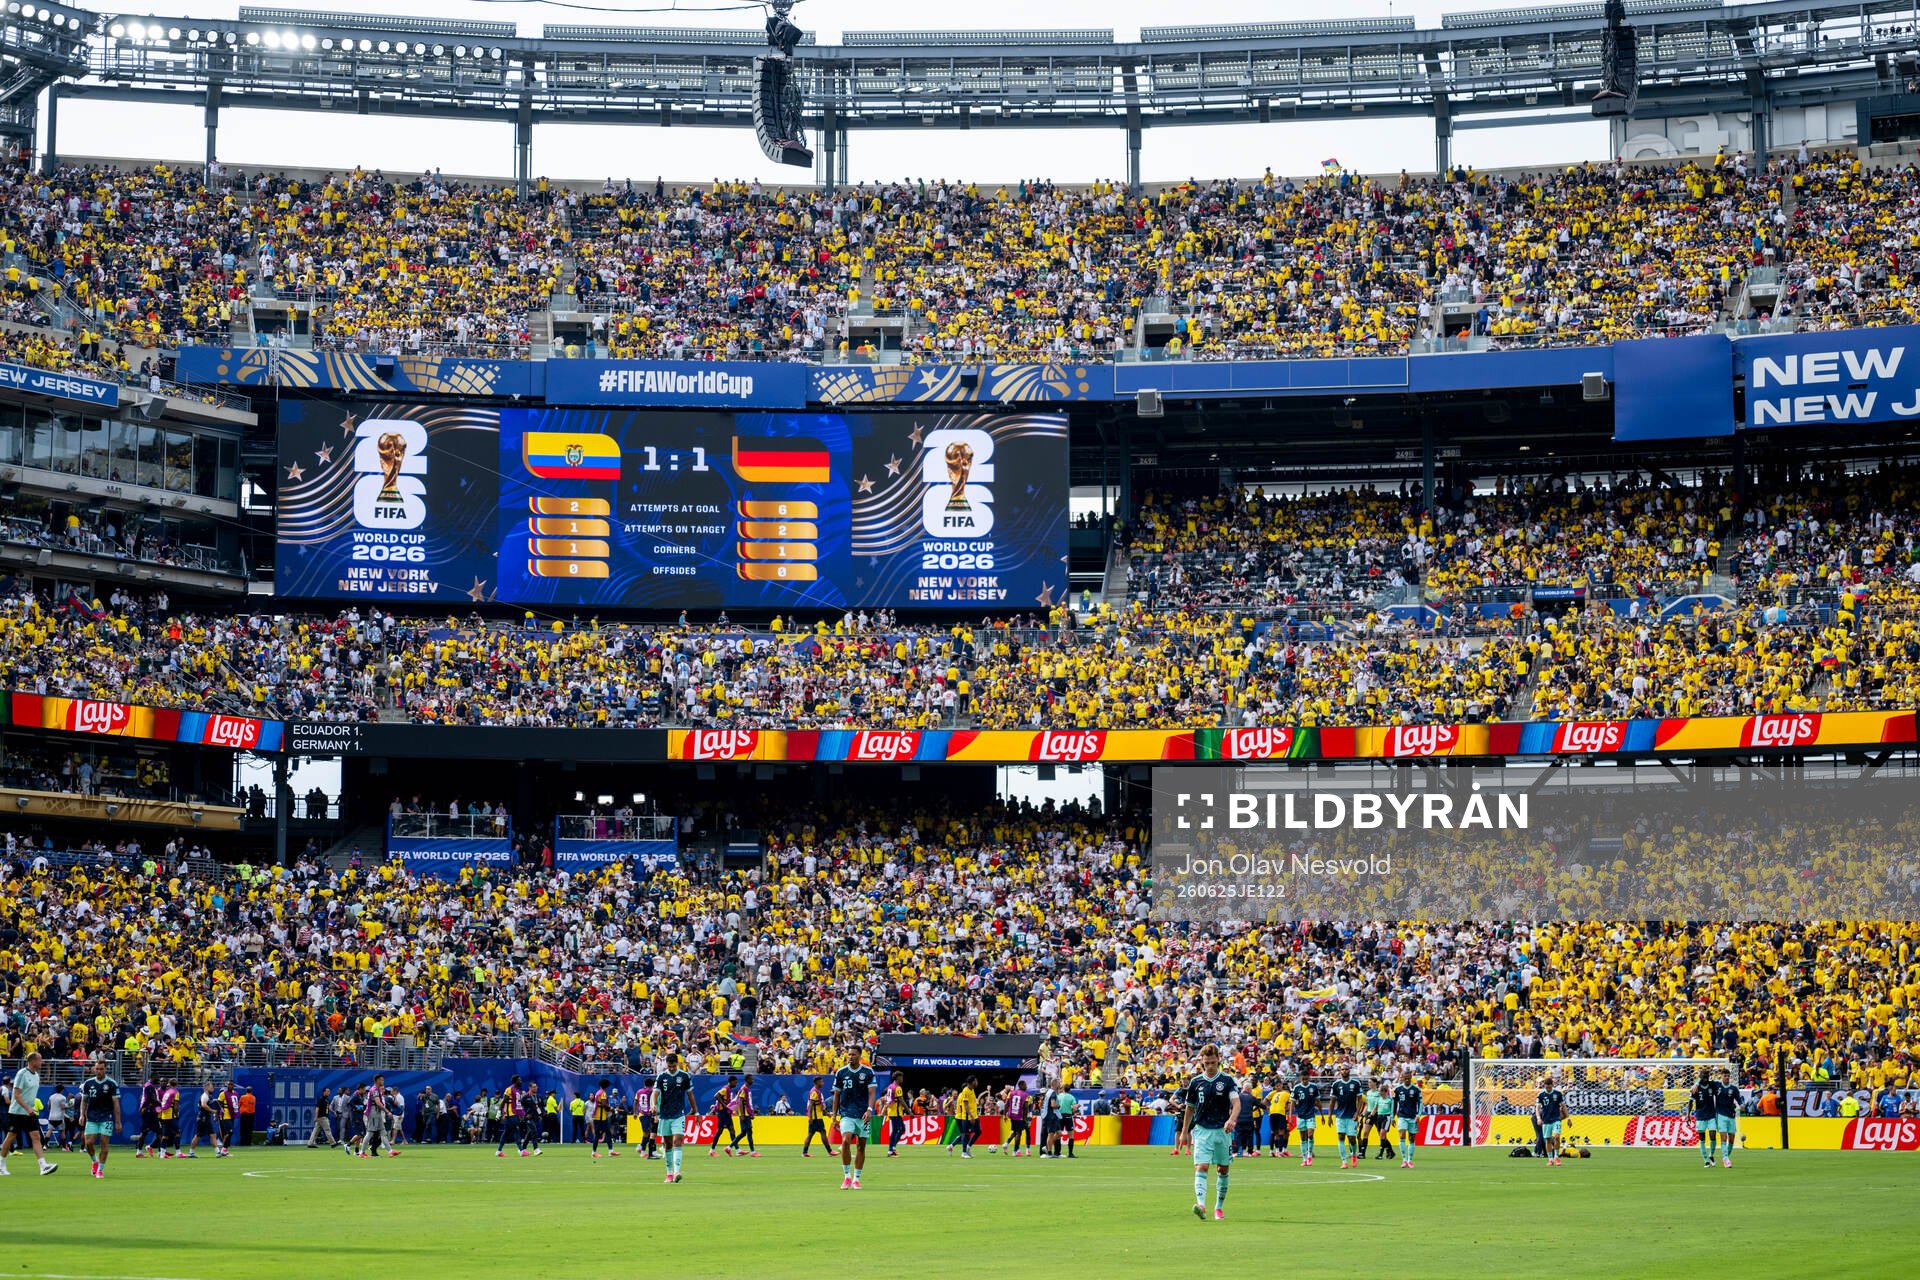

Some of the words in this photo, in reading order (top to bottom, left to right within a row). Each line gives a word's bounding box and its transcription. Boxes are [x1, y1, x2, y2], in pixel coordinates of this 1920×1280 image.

[1753, 347, 1905, 388] NEW
[31, 376, 107, 398] JERSEY
[600, 370, 753, 398] #FIFAWorldCup
[1754, 392, 1878, 425] NEW
[374, 507, 407, 519] FIFA
[570, 502, 579, 512] 2
[630, 504, 680, 513] ATTEMPTS
[682, 504, 694, 513] AT
[696, 504, 720, 514] GOAL
[778, 505, 787, 515] 6
[569, 522, 578, 533] 1
[943, 516, 975, 528] FIFA
[624, 524, 673, 534] ATTEMPTS
[675, 525, 689, 534] ON
[691, 525, 726, 534] TARGET
[778, 525, 787, 536] 2
[353, 532, 399, 543] WORLD
[401, 533, 426, 544] CUP
[569, 543, 578, 553] 1
[653, 545, 696, 555] CORNERS
[778, 546, 786, 556] 1
[922, 542, 967, 552] WORLD
[969, 542, 994, 552] CUP
[352, 545, 426, 562] 2026
[922, 554, 994, 570] 2026
[347, 567, 383, 579] NEW
[387, 568, 430, 580] YORK
[653, 566, 696, 576] OFFSIDES
[338, 579, 374, 592] NEW
[377, 581, 438, 593] JERSEY
[918, 576, 952, 588] NEW
[956, 576, 998, 588] YORK
[909, 589, 944, 601] NEW
[947, 589, 1007, 600] JERSEY
[211, 714, 255, 748] Lay's
[293, 725, 350, 736] ECUADOR
[354, 726, 363, 736] 1.
[1562, 721, 1618, 752] Lay's
[1751, 714, 1812, 747] Lay's
[292, 740, 351, 750] GERMANY
[354, 741, 363, 751] 1.
[858, 730, 913, 760] Lay's
[1039, 730, 1098, 760] Lay's
[413, 851, 450, 860] WORLD
[452, 852, 473, 861] CUP
[474, 852, 510, 861] 2026
[557, 852, 577, 861] FIFA
[580, 853, 618, 862] WORLD
[842, 1079, 853, 1089] 23
[1198, 1091, 1204, 1103] 6
[1853, 1118, 1917, 1150] Lay's
